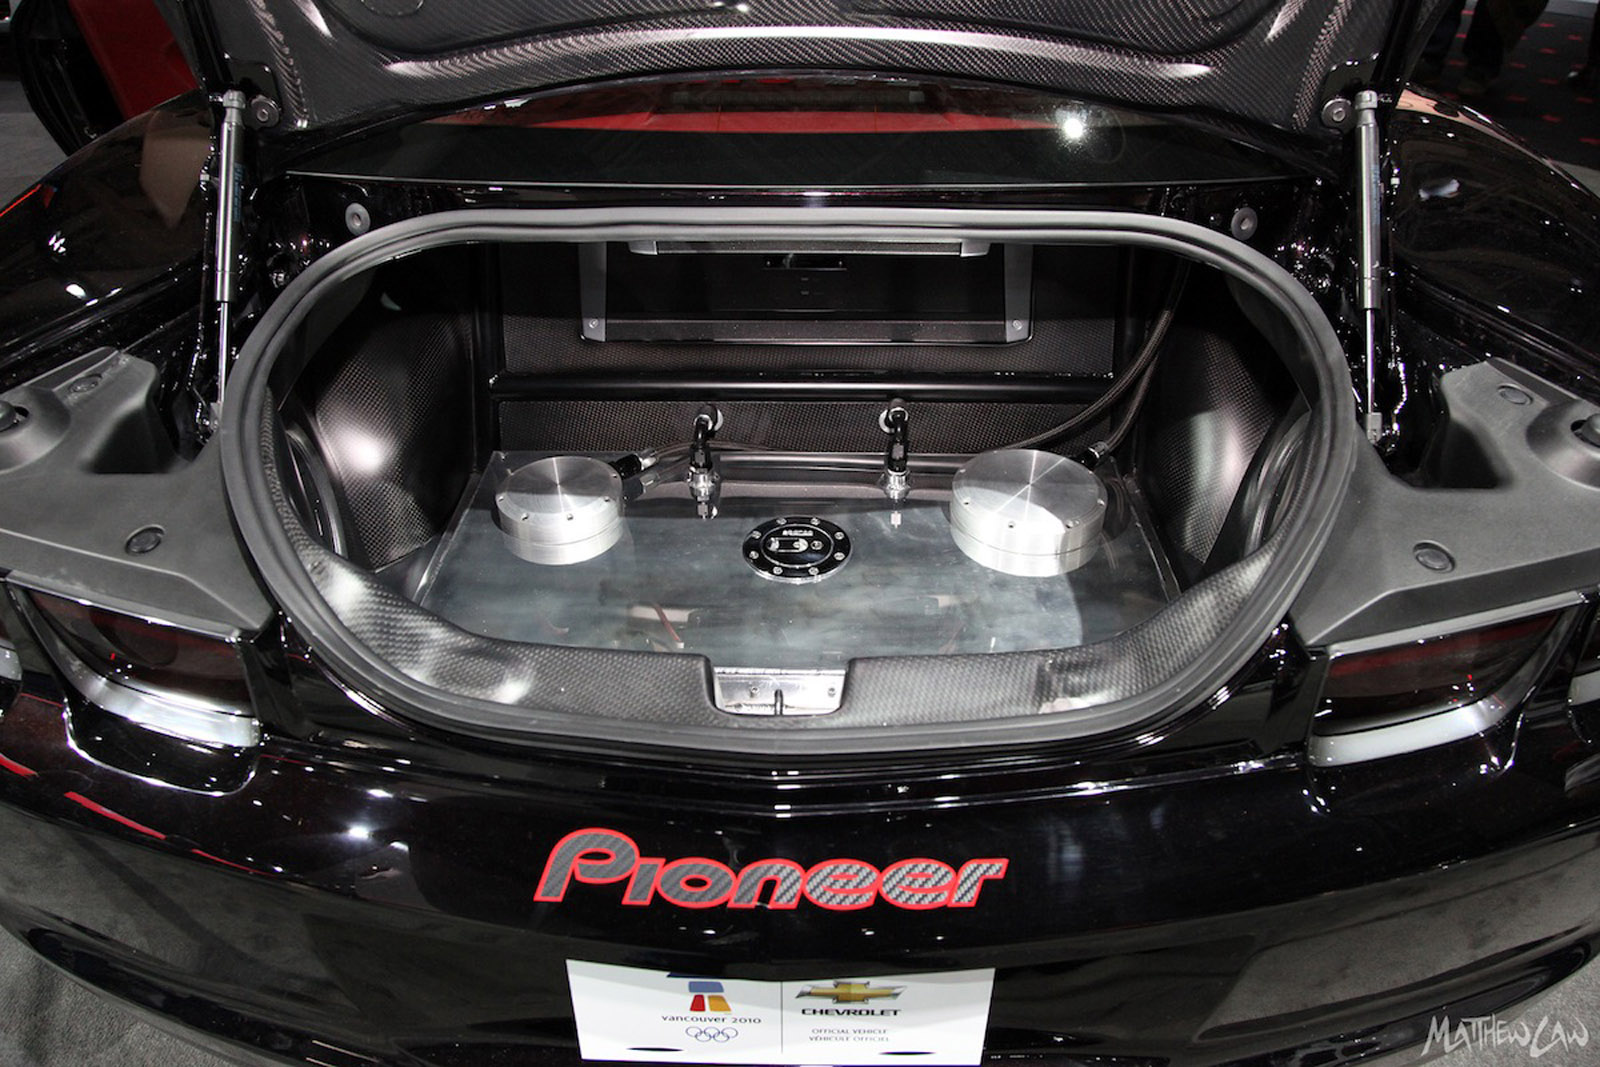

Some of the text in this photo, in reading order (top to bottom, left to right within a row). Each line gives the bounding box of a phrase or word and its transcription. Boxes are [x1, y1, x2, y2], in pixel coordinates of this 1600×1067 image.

[534, 827, 1009, 911] Pioneer
[801, 1008, 902, 1017] CHEVROLET
[661, 1014, 762, 1025] vancouver 2010
[811, 1027, 850, 1035] OFFICIAL
